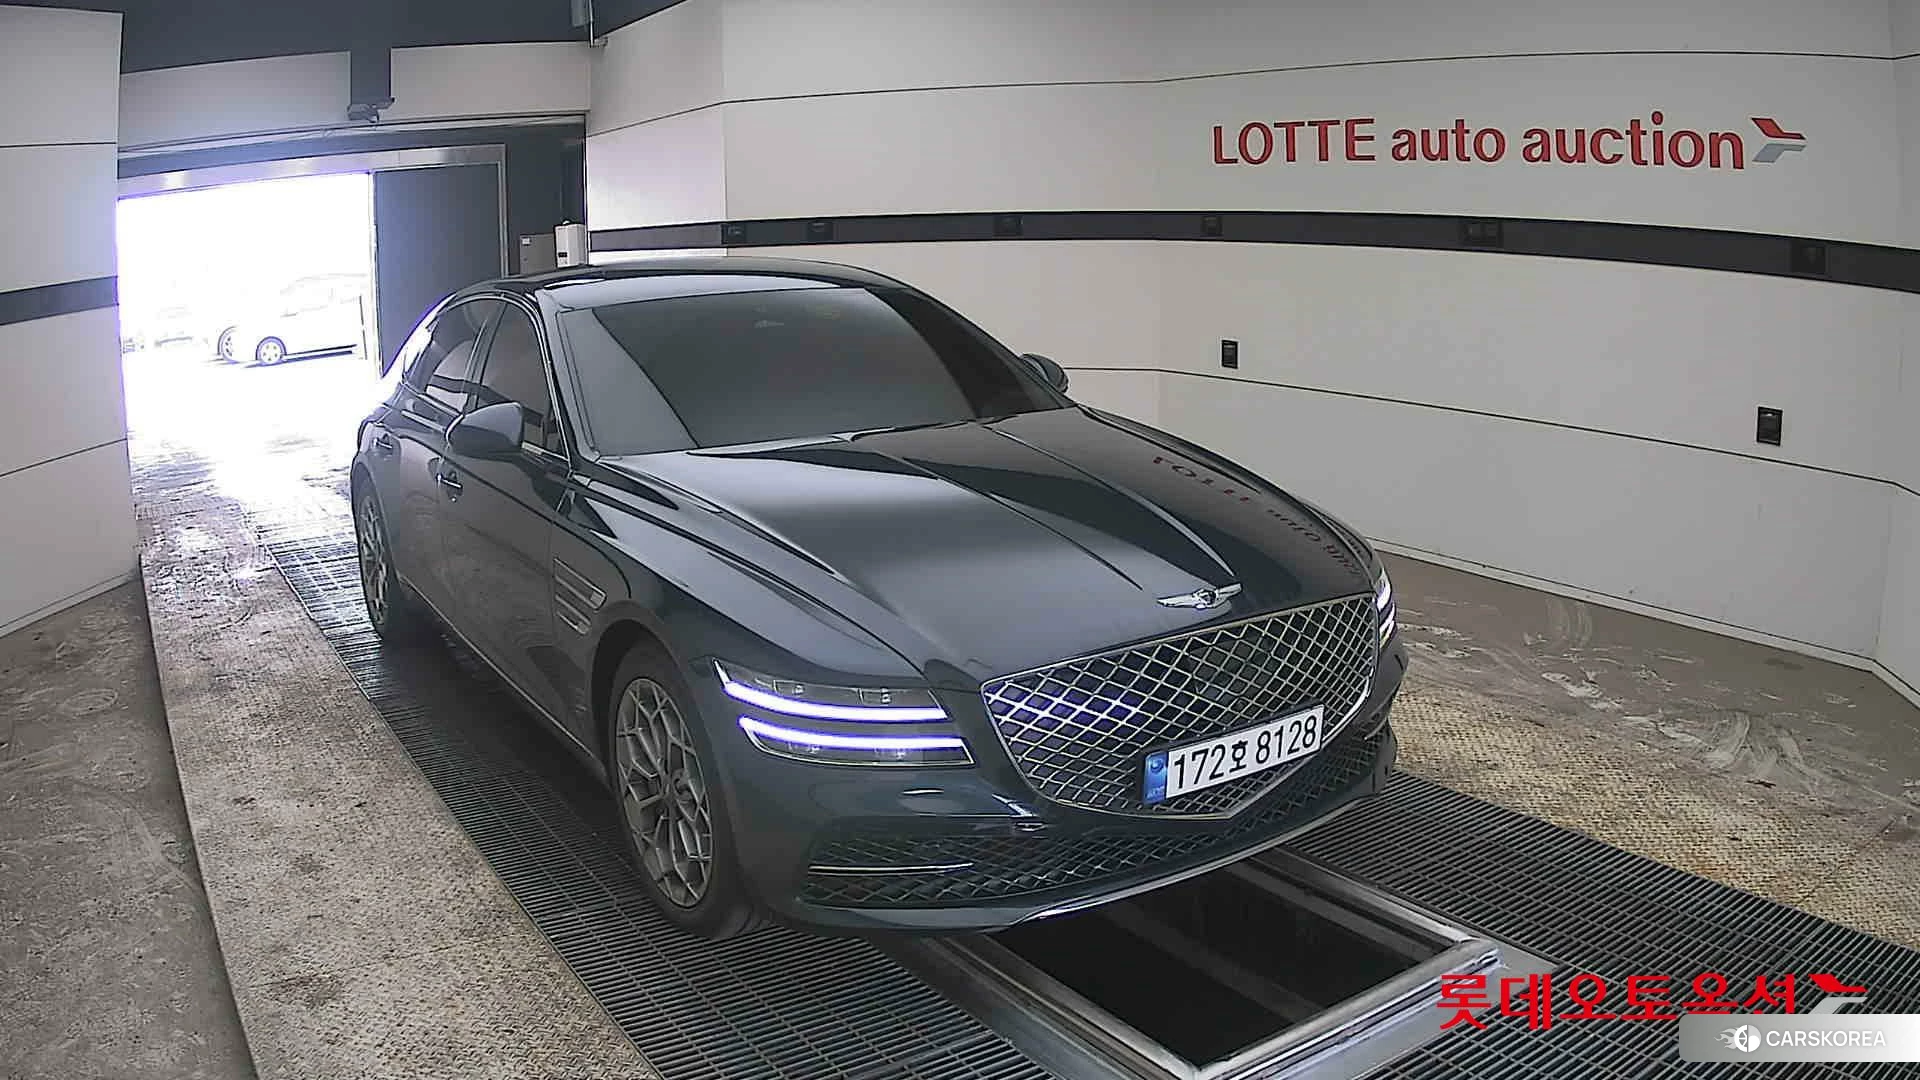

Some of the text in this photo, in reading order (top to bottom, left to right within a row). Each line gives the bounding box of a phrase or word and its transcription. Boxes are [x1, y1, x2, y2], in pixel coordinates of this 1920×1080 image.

[1213, 111, 1745, 170] LOTTE auto auction
[1174, 715, 1317, 789] 172호 8128
